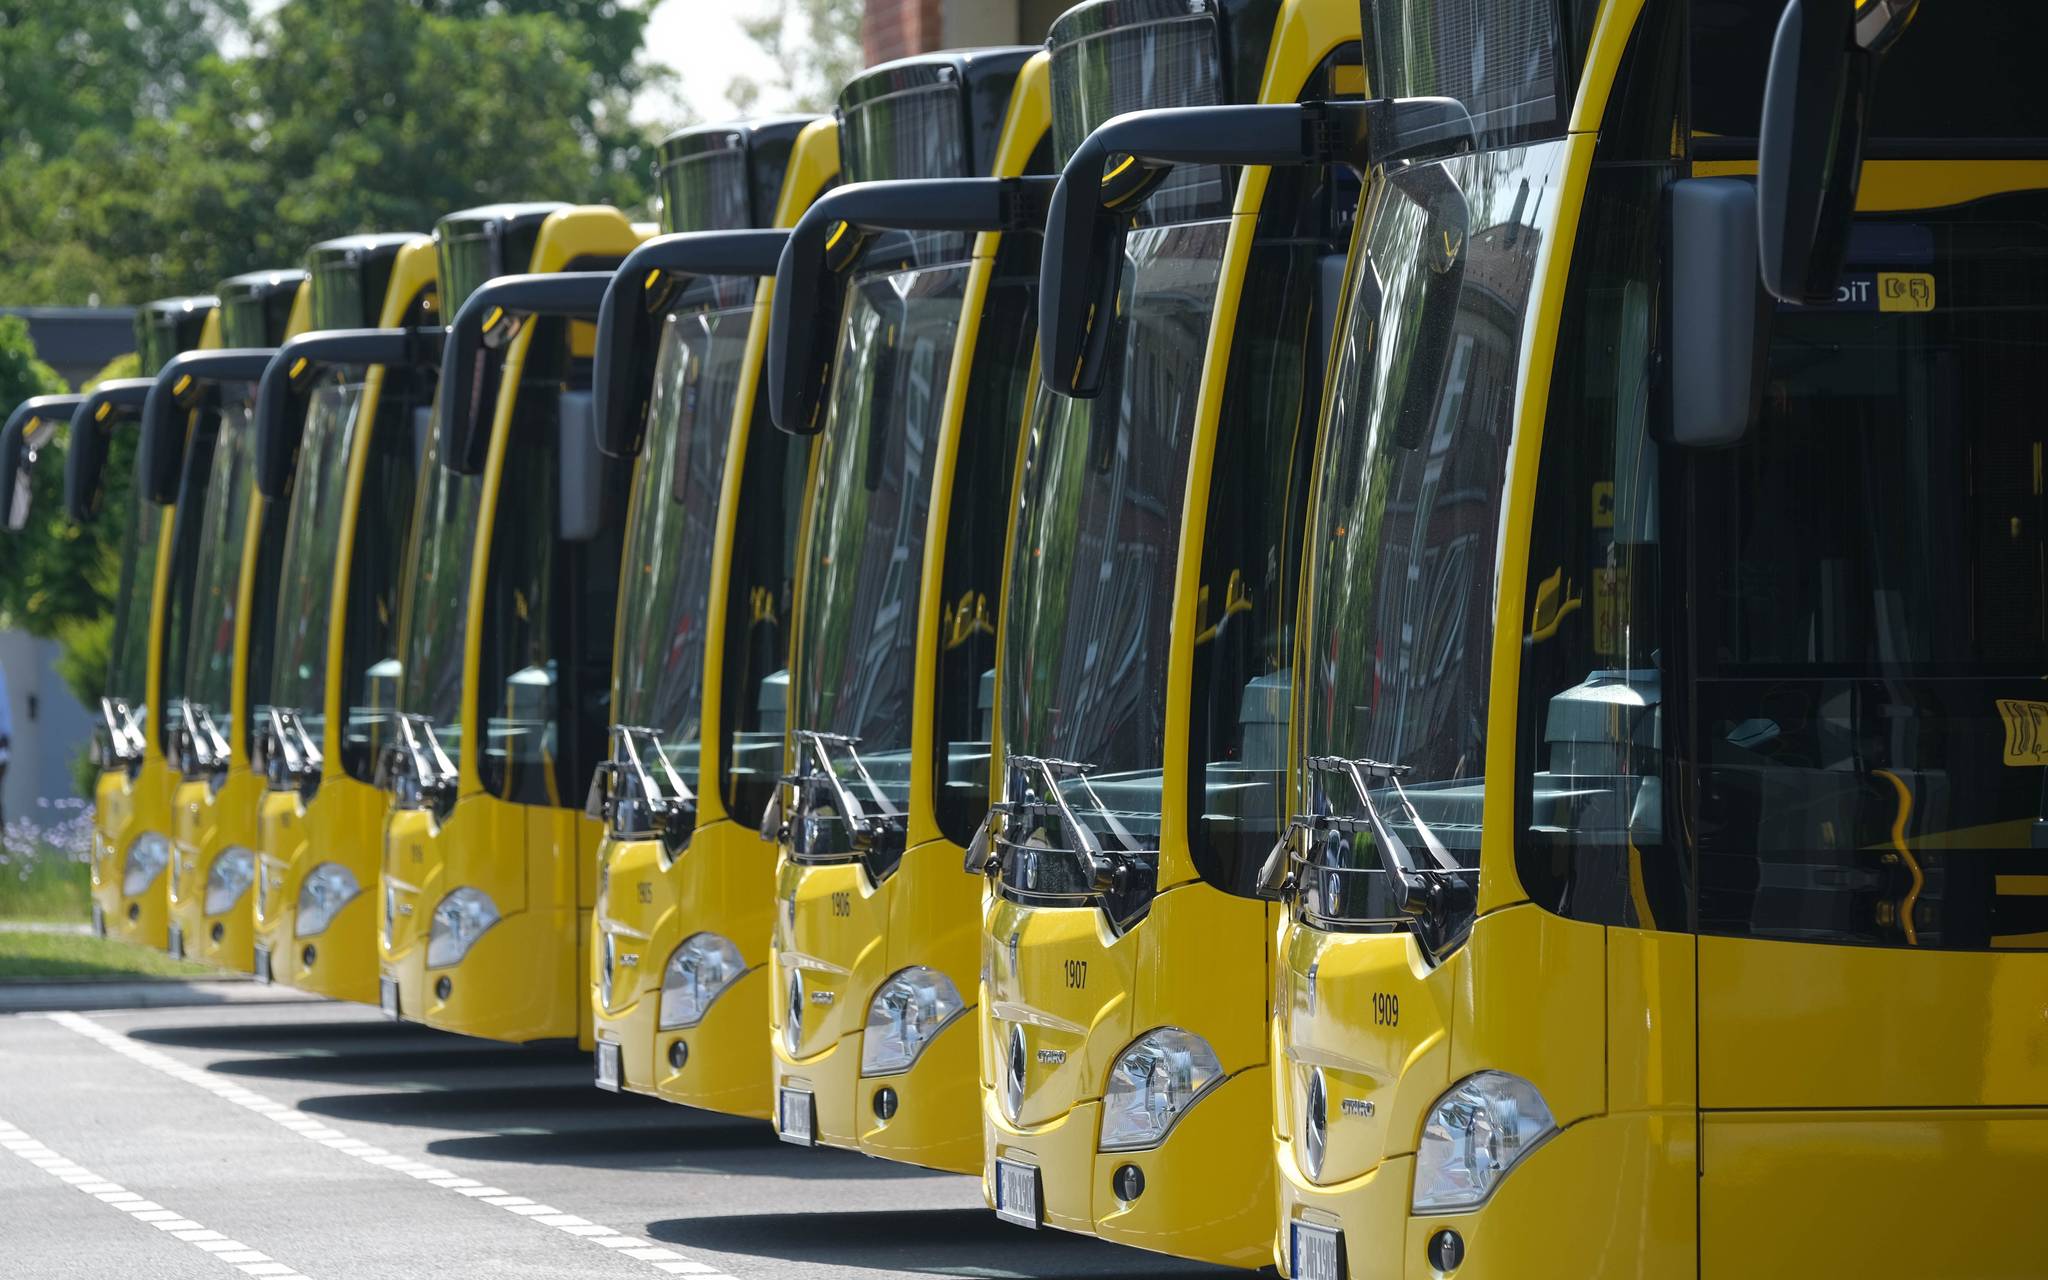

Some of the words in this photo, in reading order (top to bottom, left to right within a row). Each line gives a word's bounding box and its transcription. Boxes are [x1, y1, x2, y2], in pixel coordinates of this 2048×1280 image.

[831, 891, 850, 917] 1906
[1064, 959, 1088, 990] 1907
[1372, 991, 1400, 1028] 1909
